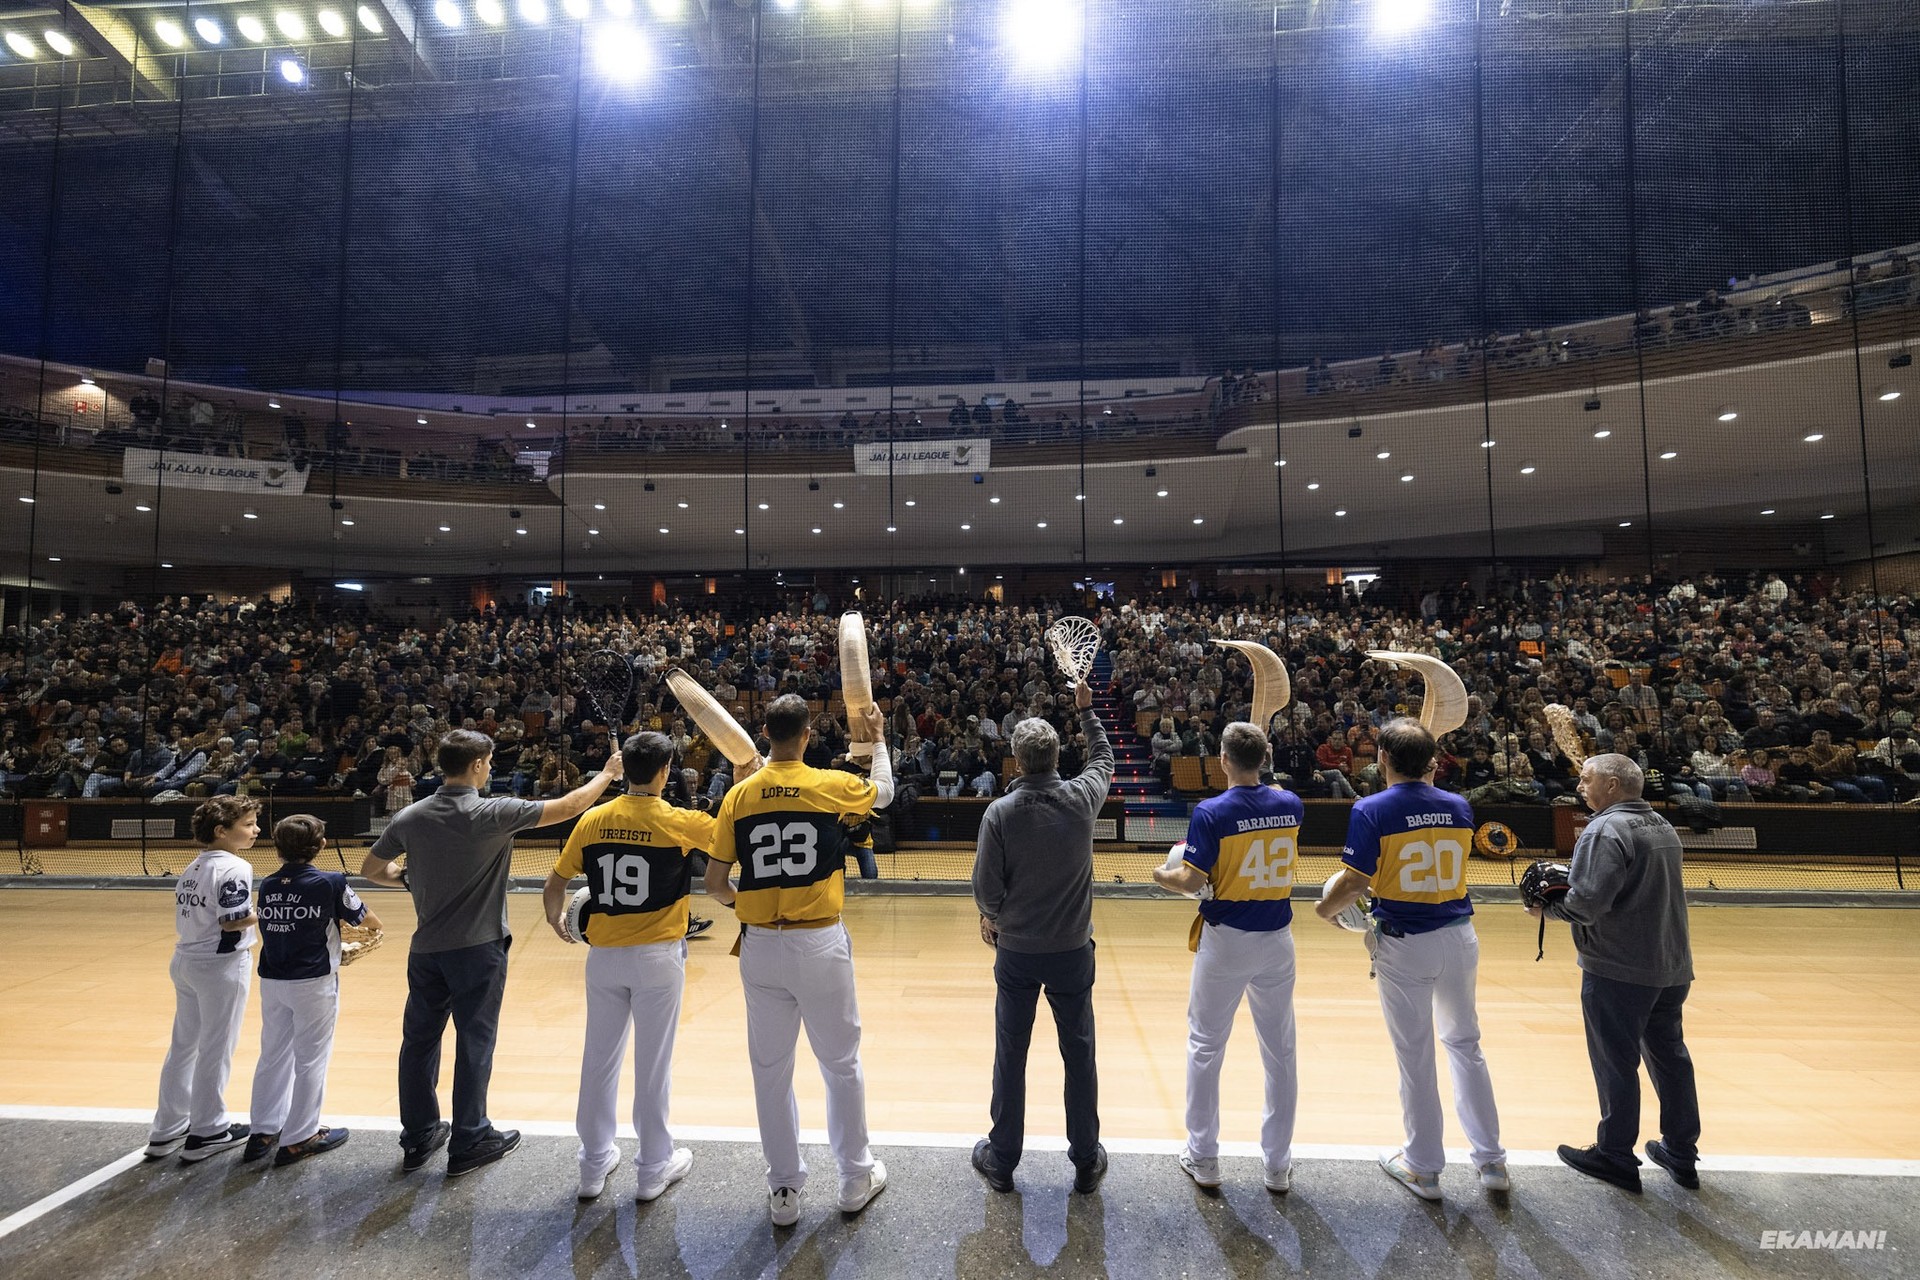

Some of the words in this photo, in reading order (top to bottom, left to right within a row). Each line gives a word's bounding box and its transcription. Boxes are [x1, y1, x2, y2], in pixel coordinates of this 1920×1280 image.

[869, 452, 887, 462] JAI
[888, 452, 911, 461] ALAI
[913, 451, 951, 461] LEAGUE
[148, 461, 173, 471] JAI
[174, 464, 207, 475] ALAI
[209, 467, 261, 479] LEAGUE
[761, 786, 800, 799] LOPEZ
[1236, 814, 1298, 832] BARANDIKA
[1405, 813, 1454, 828] BASQUE
[599, 829, 653, 842] URREISTI
[749, 821, 818, 879] 23
[1238, 836, 1295, 890] 42
[1398, 839, 1464, 893] 20
[596, 853, 650, 907] 19
[265, 893, 283, 904] BAR
[287, 893, 302, 903] DU
[266, 923, 296, 933] BIDART
